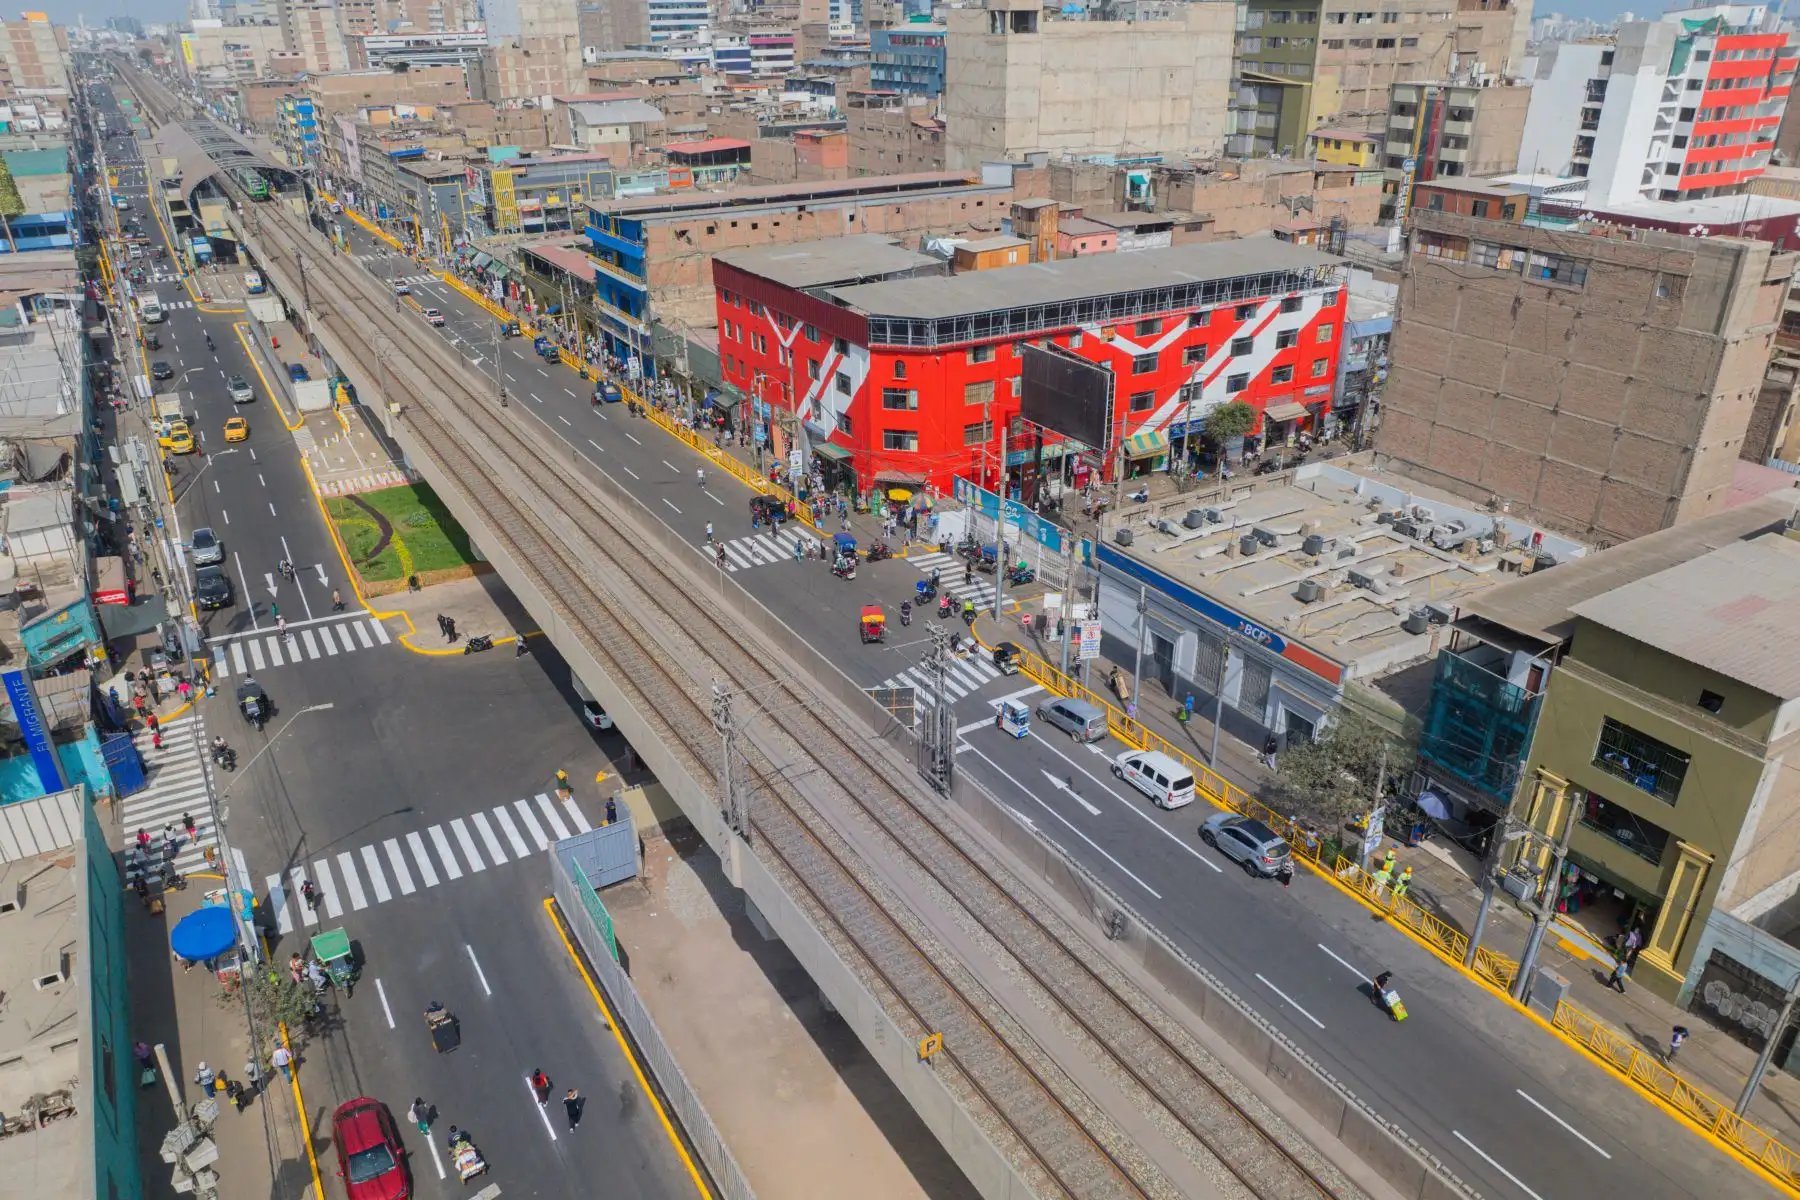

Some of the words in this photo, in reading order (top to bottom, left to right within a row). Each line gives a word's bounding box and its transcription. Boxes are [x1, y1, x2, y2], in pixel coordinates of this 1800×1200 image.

[1244, 623, 1268, 642] BCP
[12, 679, 44, 737] MIGRANTE
[36, 741, 49, 752] EL
[926, 1039, 936, 1053] P
